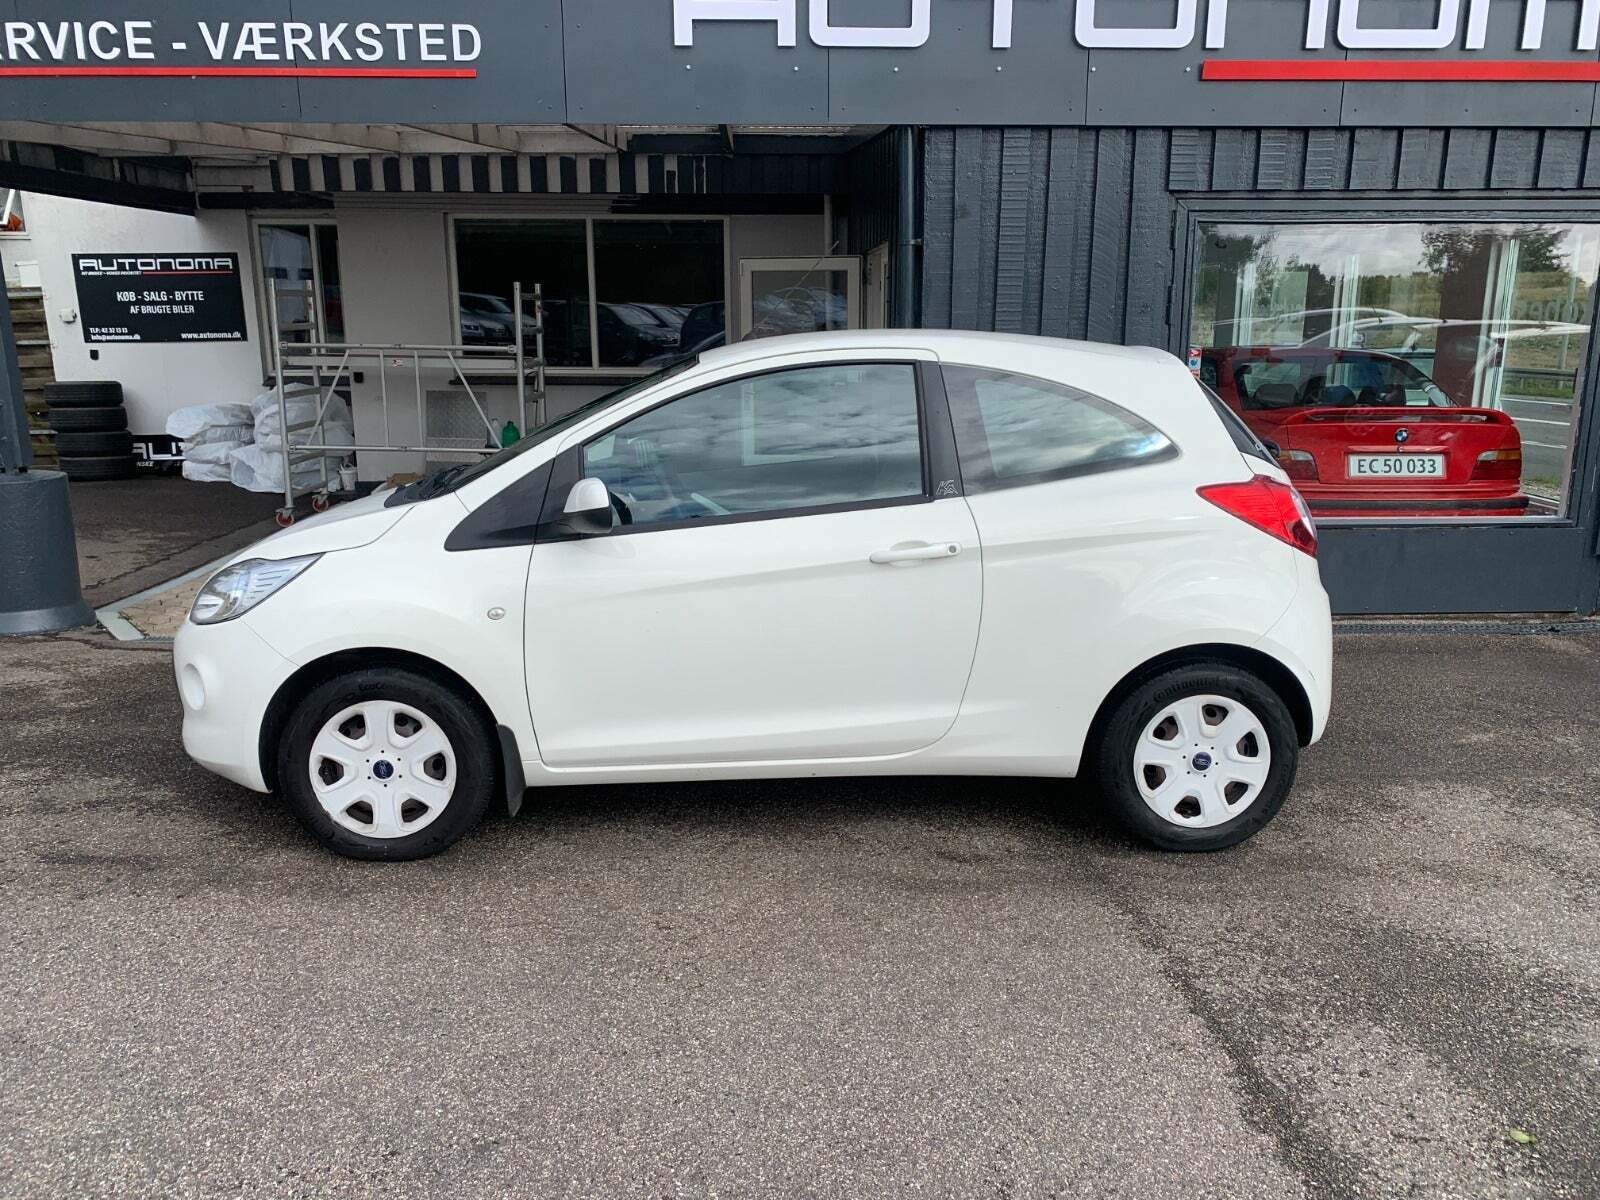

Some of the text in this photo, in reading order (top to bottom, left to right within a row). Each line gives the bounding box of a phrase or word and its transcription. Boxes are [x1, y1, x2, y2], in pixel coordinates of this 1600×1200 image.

[0, 20, 155, 61] RVICE
[198, 21, 483, 62] VÆRKSTED
[79, 258, 233, 271] AUTONOMA
[116, 291, 136, 302] KØB
[143, 291, 168, 302] SALG
[174, 290, 205, 301] BYTTE
[130, 304, 195, 314] AF BRUGTE BILER
[181, 331, 242, 339] www.autonoma.dk
[1357, 458, 1437, 474] EC 50 033
